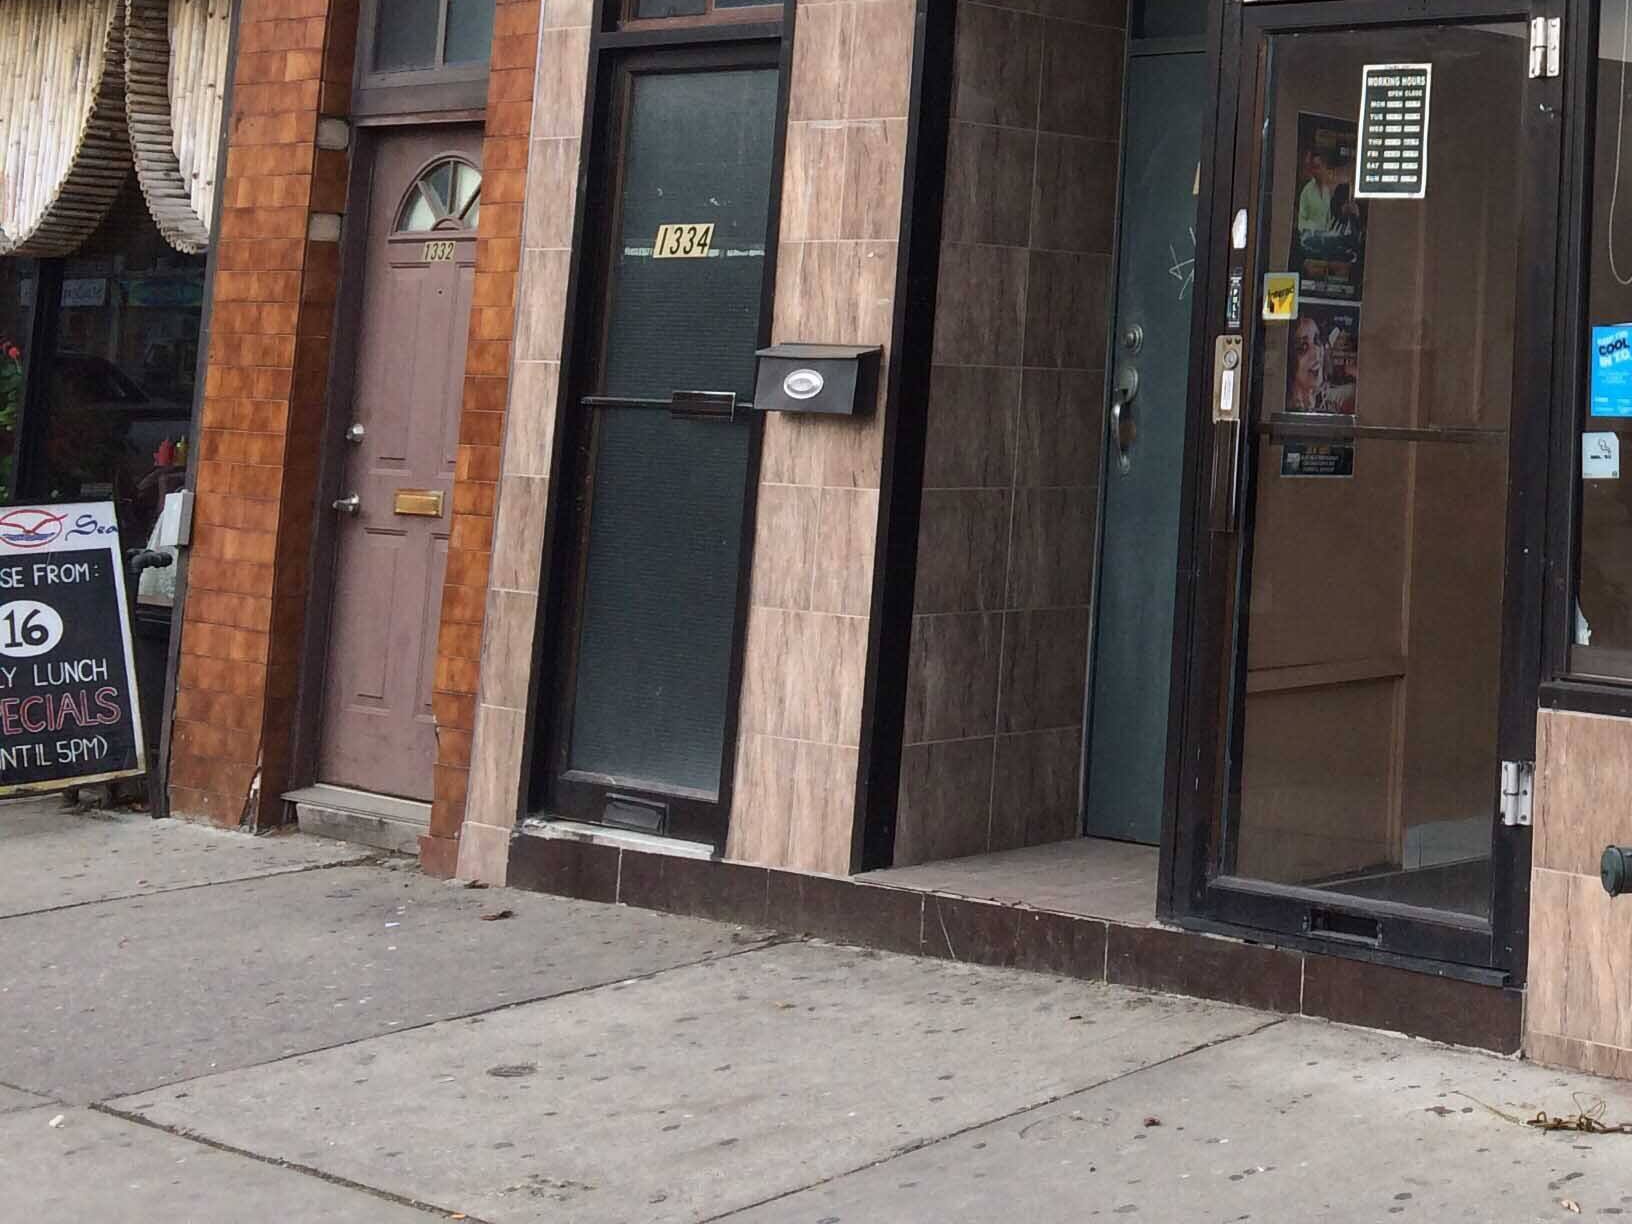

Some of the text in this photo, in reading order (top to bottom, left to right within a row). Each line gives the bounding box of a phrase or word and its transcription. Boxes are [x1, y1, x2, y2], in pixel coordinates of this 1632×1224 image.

[1402, 75, 1426, 86] HOURS
[424, 242, 455, 261] 1332
[658, 226, 711, 255] 1334
[1598, 337, 1631, 356] COOL
[65, 513, 118, 541] Sea
[33, 563, 99, 586] FROM:
[4, 608, 49, 648] 16
[0, 658, 108, 689] Y LUNCH
[0, 687, 121, 735] ECIALS
[0, 734, 108, 771] NTIL 5PM)
